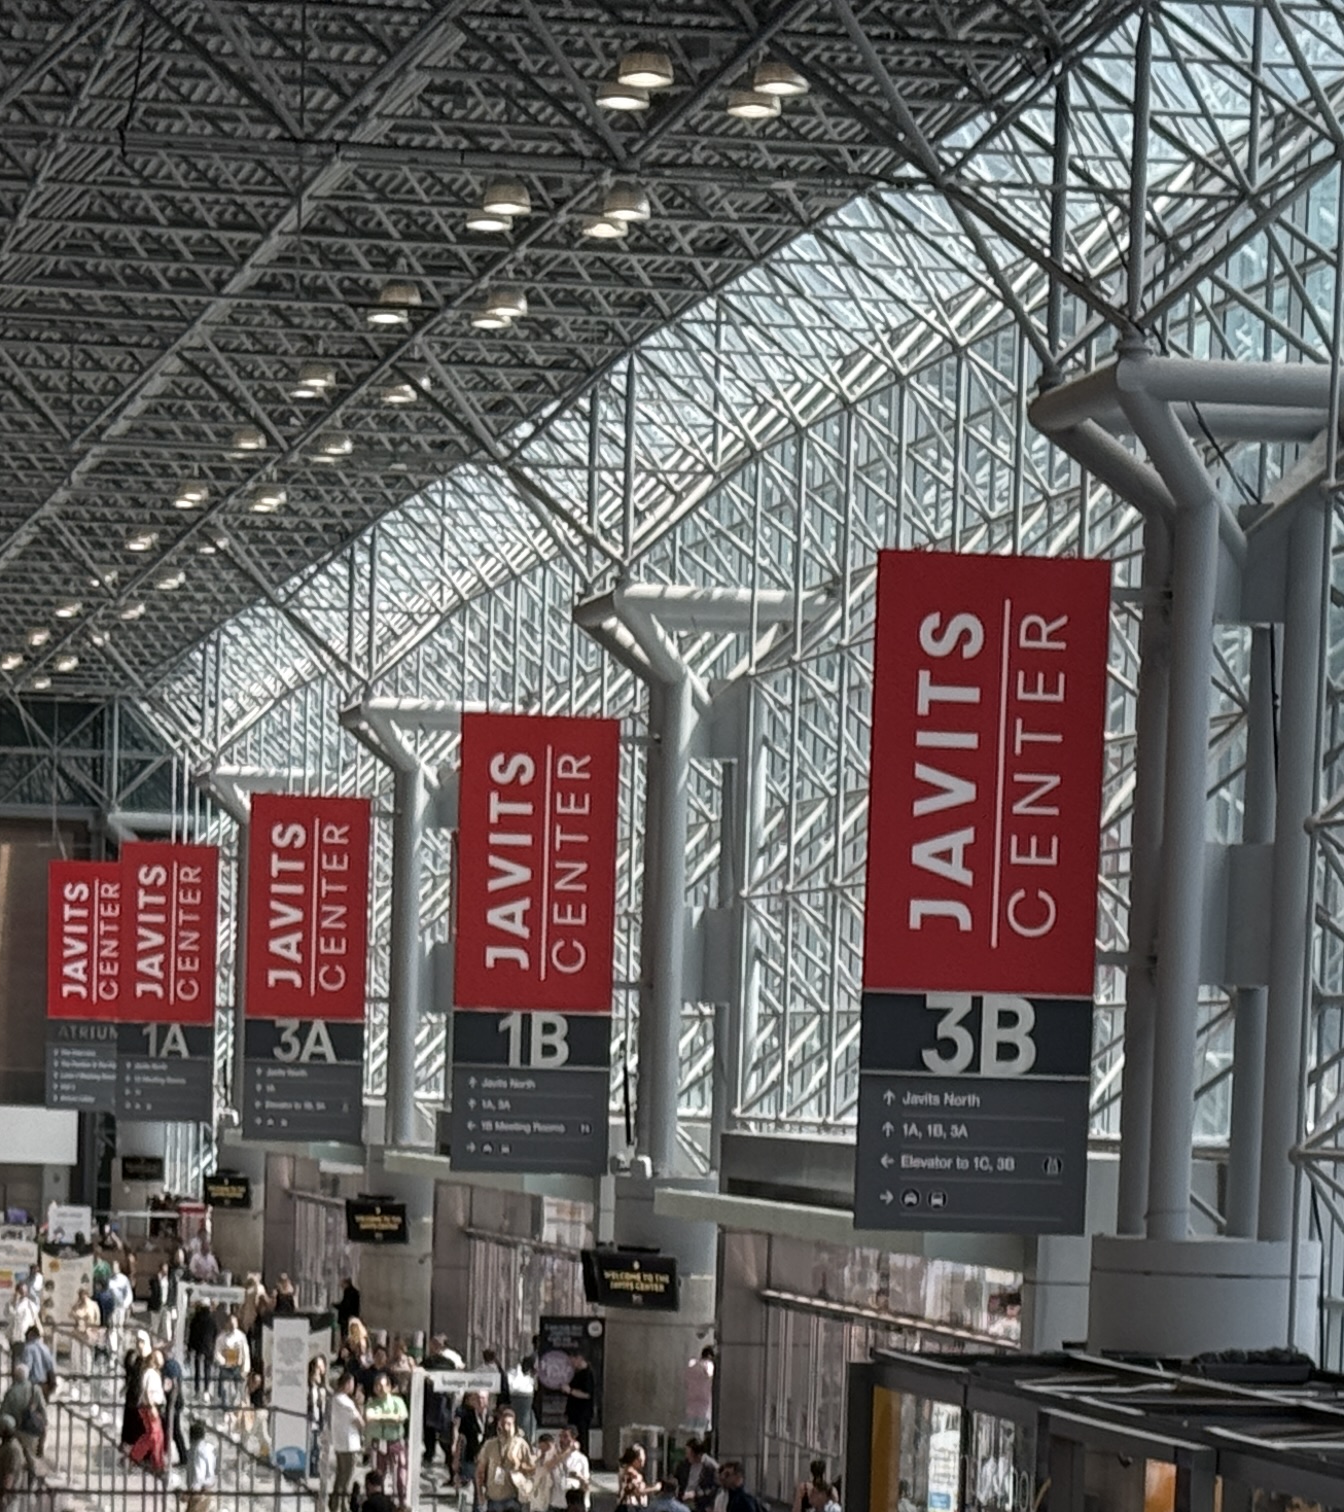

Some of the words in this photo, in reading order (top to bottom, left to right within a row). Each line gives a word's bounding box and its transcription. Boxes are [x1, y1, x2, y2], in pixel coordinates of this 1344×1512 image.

[909, 611, 984, 931] JAVITS
[1007, 612, 1068, 938] CENTER
[267, 822, 307, 989] JAVITS
[318, 823, 350, 992] CENTER
[485, 752, 536, 970] JAVITS
[551, 753, 592, 974] CENTER
[61, 881, 89, 999] JAVITS
[98, 881, 121, 1001] CENTER
[135, 864, 167, 999] JAVITS
[176, 865, 202, 1001] CENTER
[142, 1022, 191, 1058] 1A
[272, 1019, 338, 1063] 3A
[498, 1011, 570, 1068] 1B
[921, 993, 1037, 1076] 3B
[901, 1155, 953, 1169] Elevator
[956, 1157, 969, 1170] to
[902, 1091, 940, 1106] Javits
[944, 1092, 981, 1107] North
